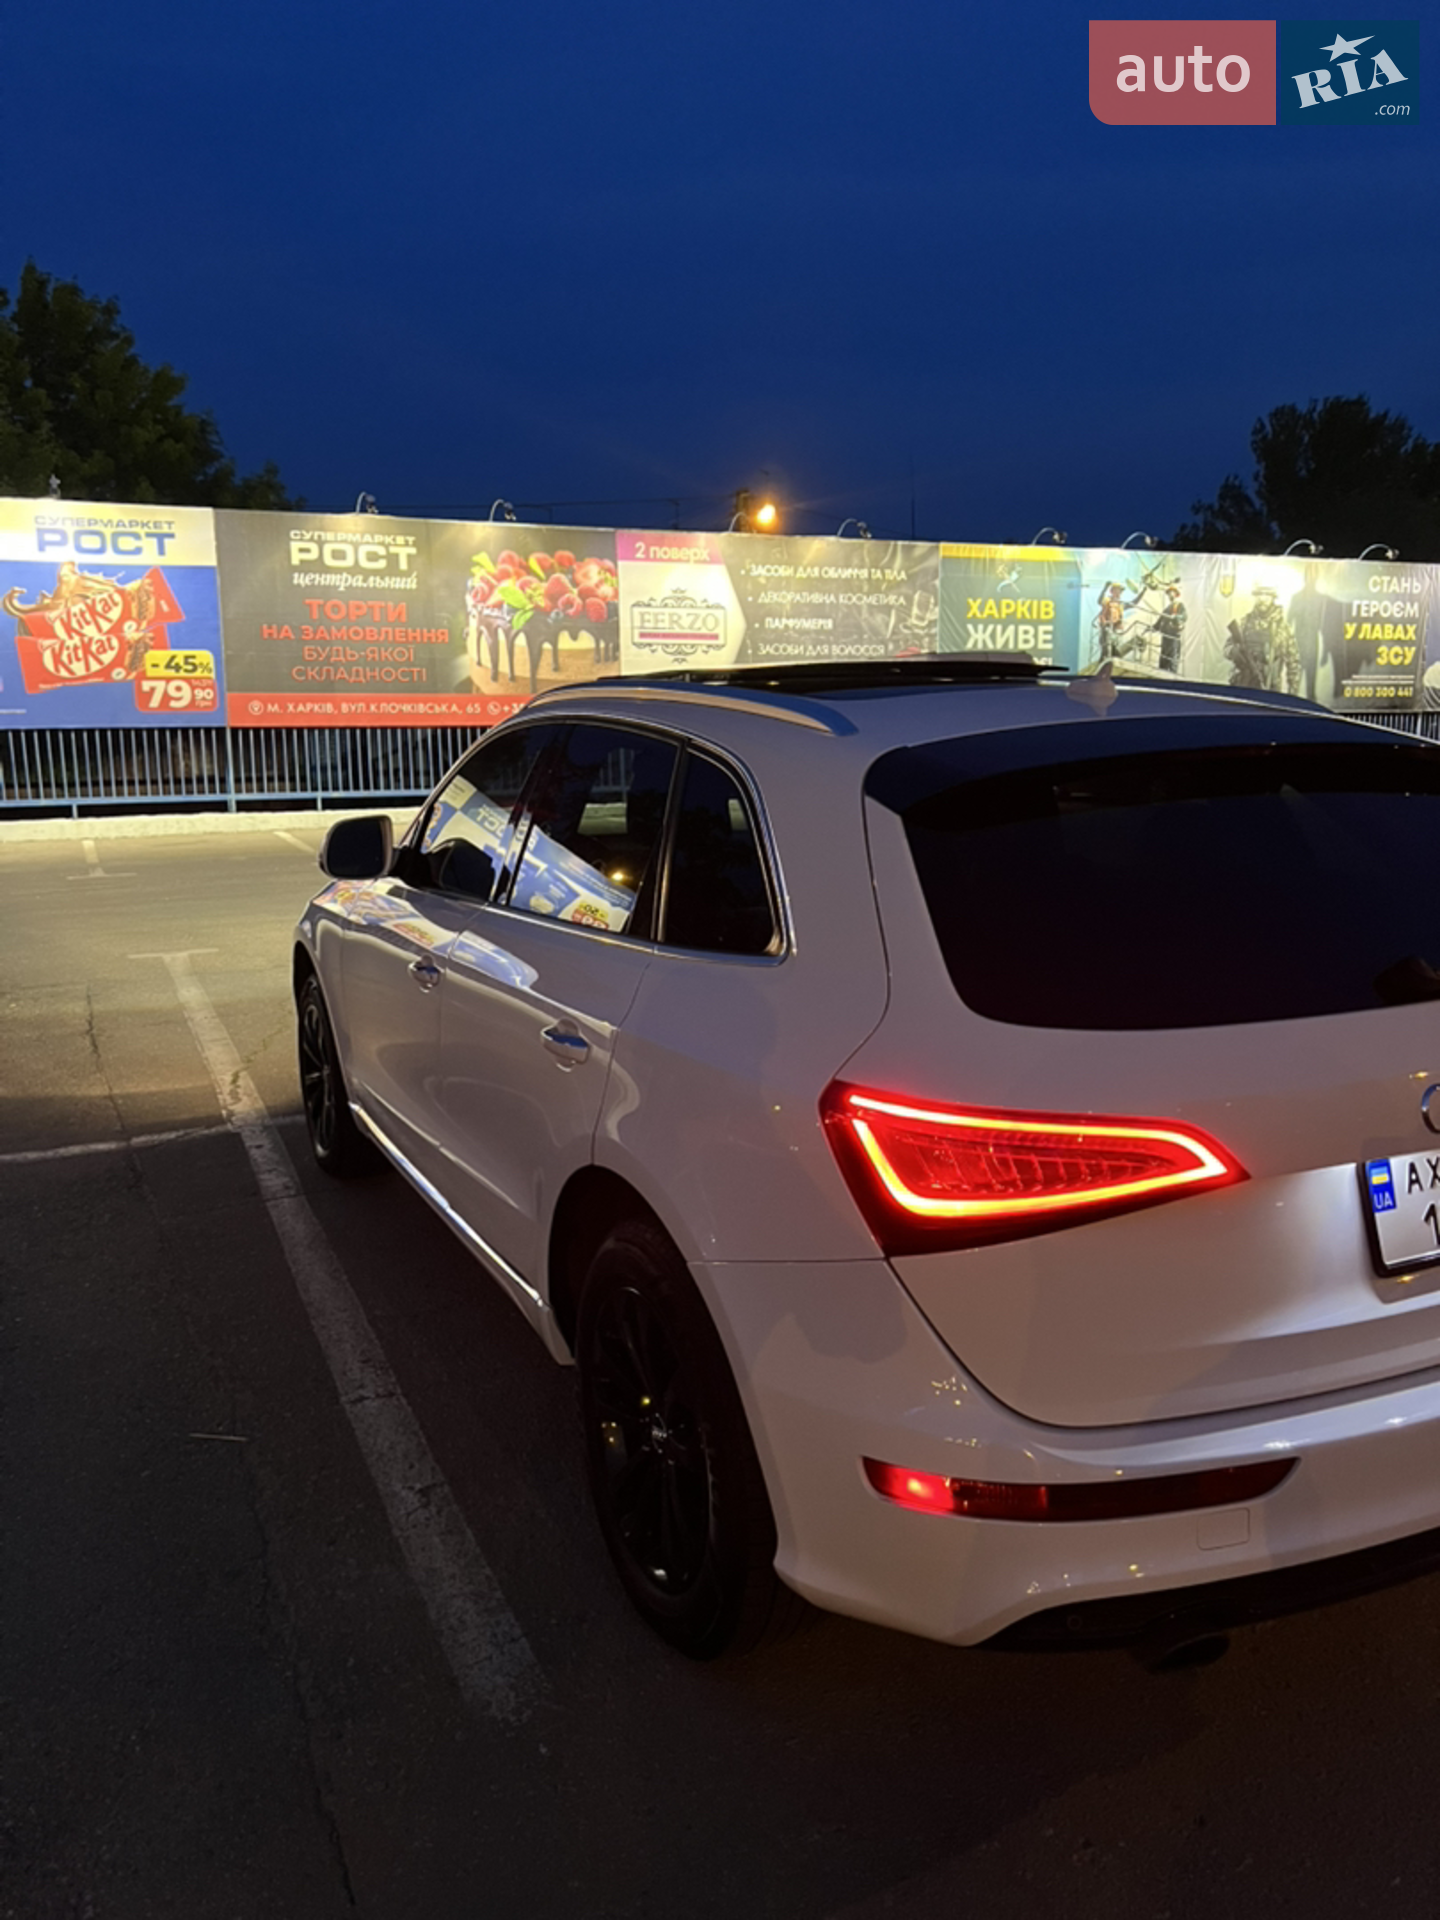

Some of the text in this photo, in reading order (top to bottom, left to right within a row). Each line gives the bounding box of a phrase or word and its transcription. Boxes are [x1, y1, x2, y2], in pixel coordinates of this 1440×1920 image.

[34, 515, 175, 530] СУПЕРМАРКЕТ
[36, 528, 176, 556] РОСТ
[289, 530, 416, 545] СУПЕРМАРКЕТ
[290, 541, 417, 570] РОСТ
[635, 541, 711, 564] 2 поверх
[292, 571, 418, 591] центральний
[1368, 575, 1421, 593] СТАНЬ
[757, 591, 836, 604] ДЕКОРАТИВНА
[303, 599, 407, 622] ТОРТИ
[967, 598, 1055, 619] ХАРКІВ
[1352, 600, 1419, 618] ГЕРОЄМ
[261, 624, 449, 643] НА ЗАМОВЛЕННЯ
[966, 624, 1054, 649] ЖИВЕ
[1344, 622, 1417, 641] У ЛАВАХ
[303, 645, 415, 664] БУДЬ-ЯКОЇ
[1376, 646, 1416, 666] ЗСУ
[291, 665, 427, 683] СКЛАДНОСТІ
[267, 703, 283, 714] М.
[287, 703, 337, 716] ХАРКІВ,
[466, 703, 481, 714] 65
[1374, 1191, 1393, 1210] UA
